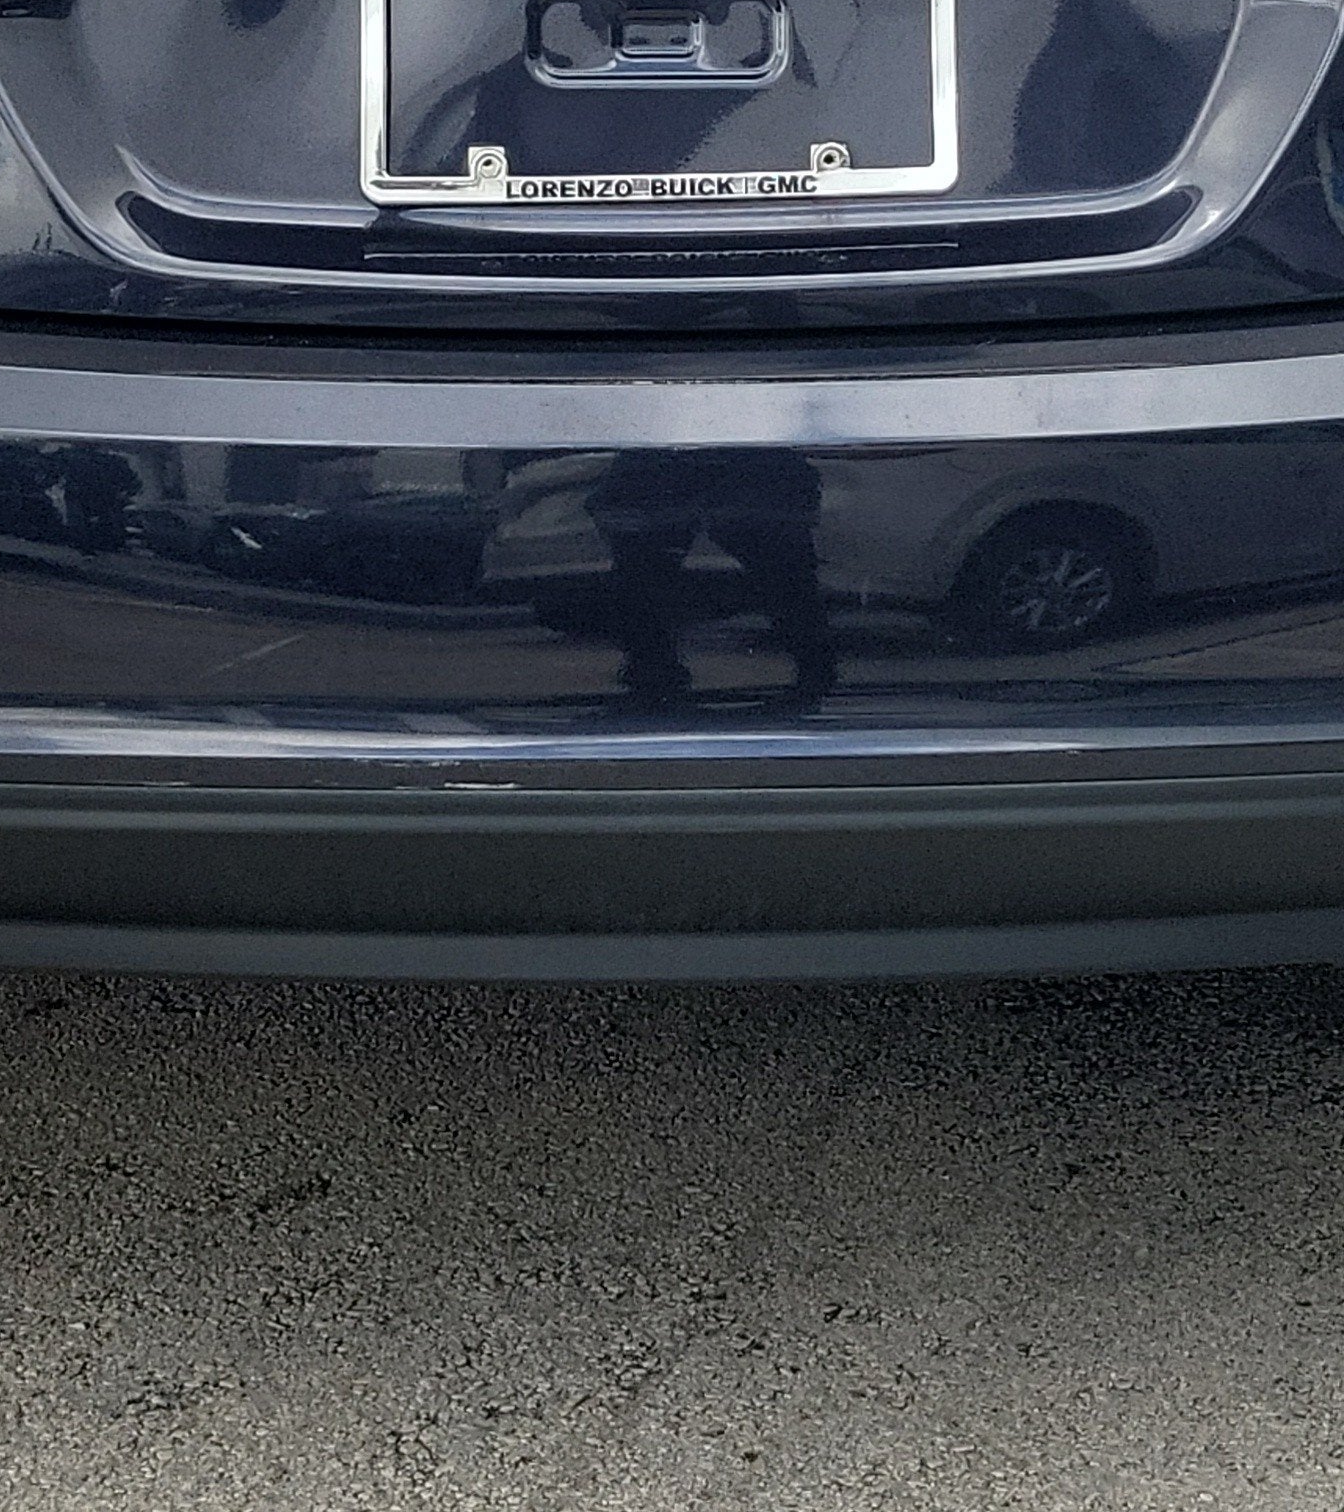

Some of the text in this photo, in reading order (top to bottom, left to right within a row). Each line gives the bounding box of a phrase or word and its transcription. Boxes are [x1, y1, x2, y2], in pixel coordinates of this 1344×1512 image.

[506, 178, 633, 199] LORENZO
[650, 176, 736, 197] BUICK
[757, 174, 818, 195] GMC
